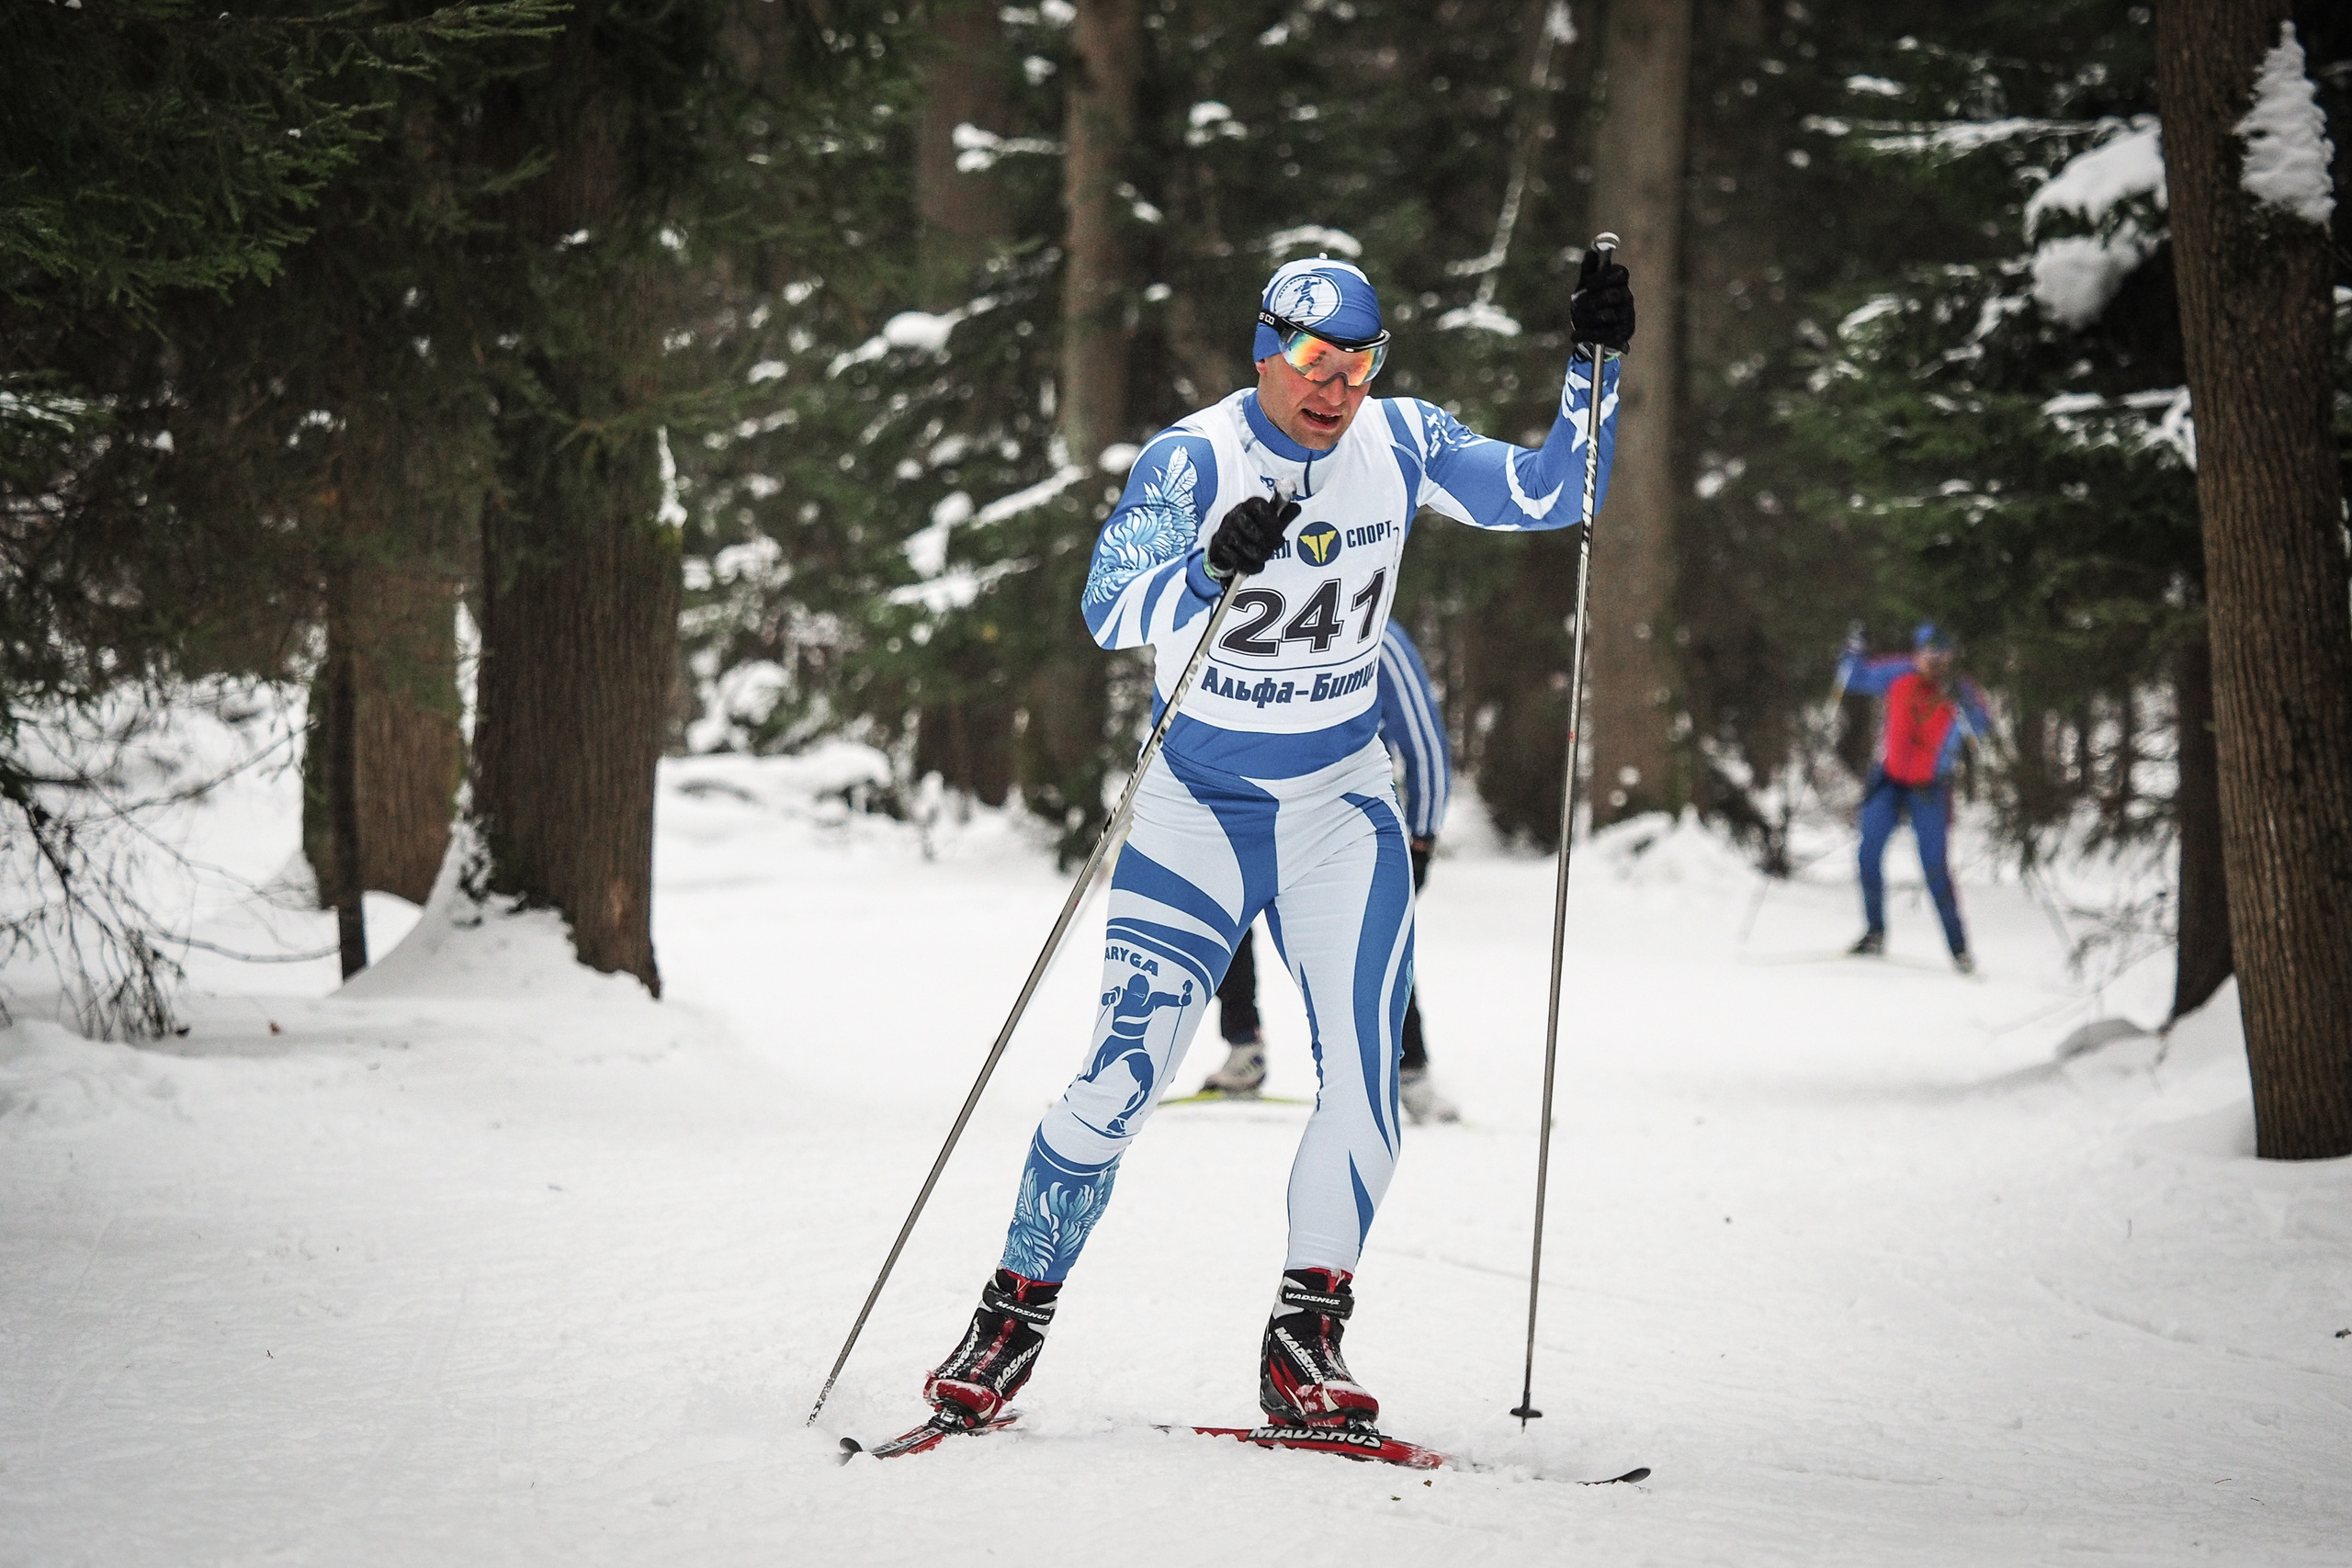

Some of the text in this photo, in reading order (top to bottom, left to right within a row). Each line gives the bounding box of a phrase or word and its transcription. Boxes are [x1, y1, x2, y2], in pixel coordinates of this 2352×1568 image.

[1346, 520, 1392, 548] СПОРТ
[1218, 567, 1386, 657] 241
[1201, 656, 1377, 708] Альфа-Битц
[996, 1300, 1050, 1321] MADSHUS
[1285, 1292, 1340, 1305] MADSHUS
[1274, 1326, 1324, 1384] MADSHUS
